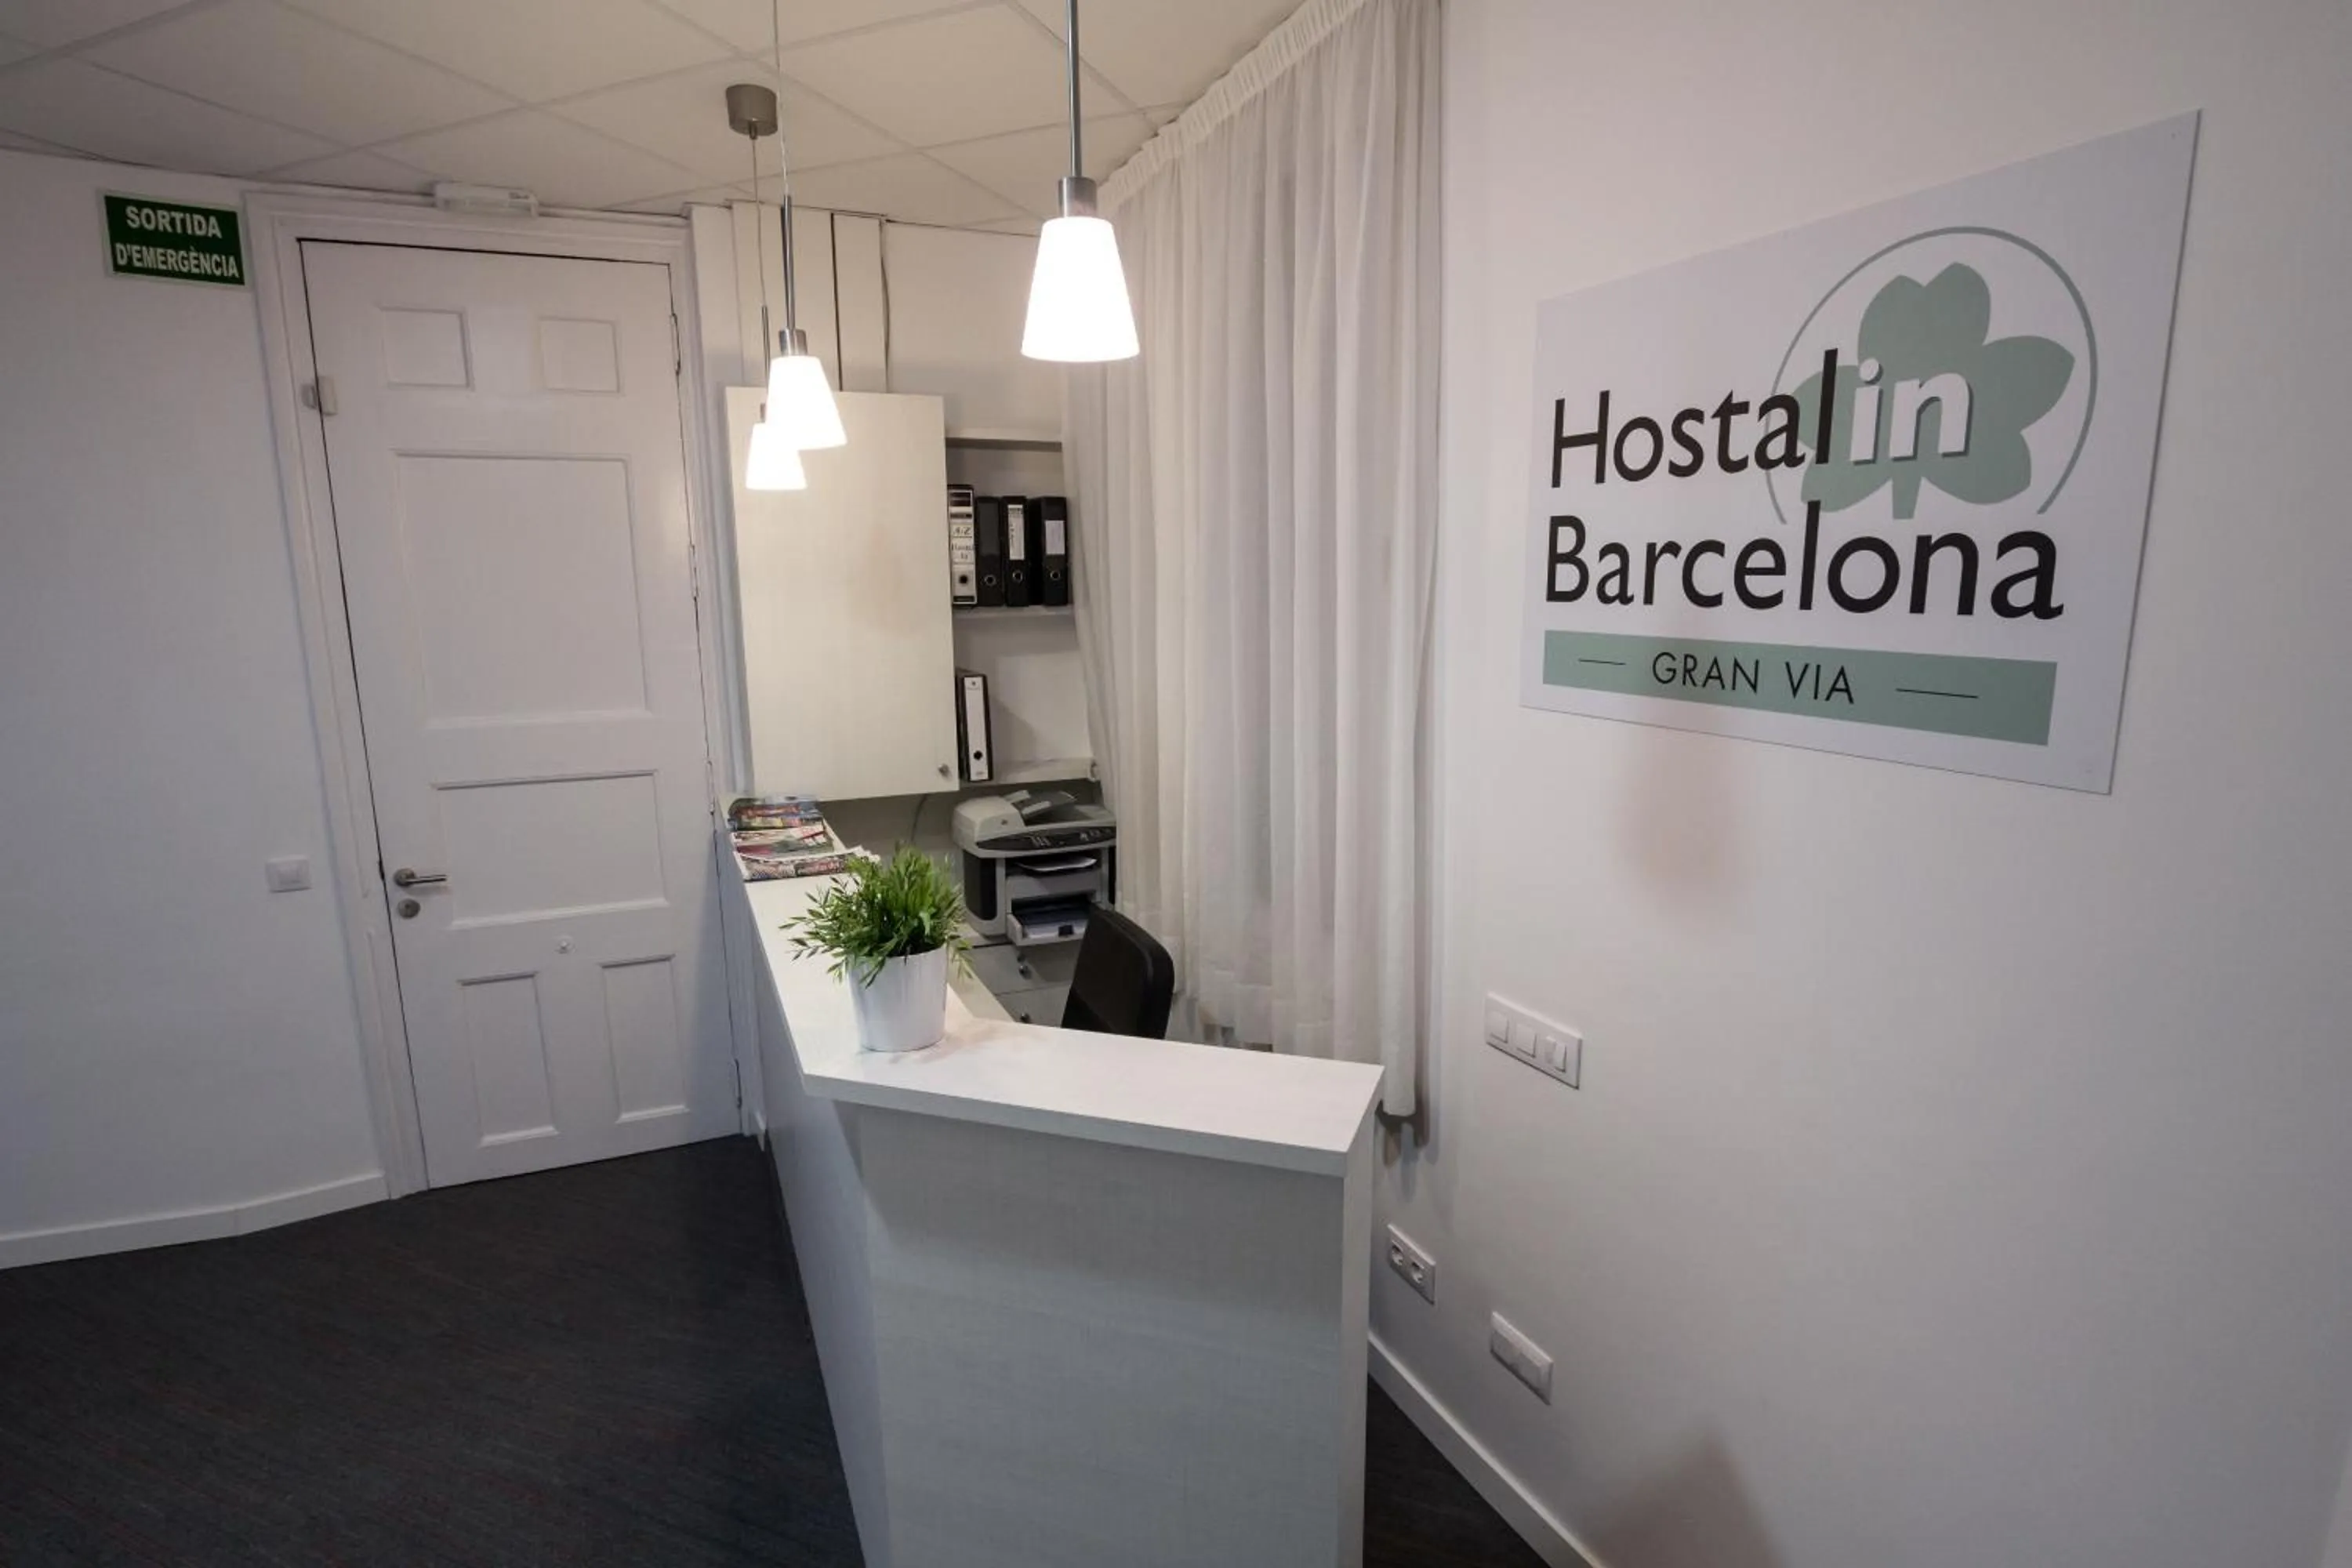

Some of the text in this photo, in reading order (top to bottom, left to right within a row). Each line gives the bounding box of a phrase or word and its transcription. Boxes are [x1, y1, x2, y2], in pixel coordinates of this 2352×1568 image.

[126, 205, 223, 238] SORTIDA
[115, 243, 239, 278] D'EMERGÈNCIA
[1545, 499, 2065, 620] Barcelona
[1651, 651, 1855, 705] GRAN VIA
